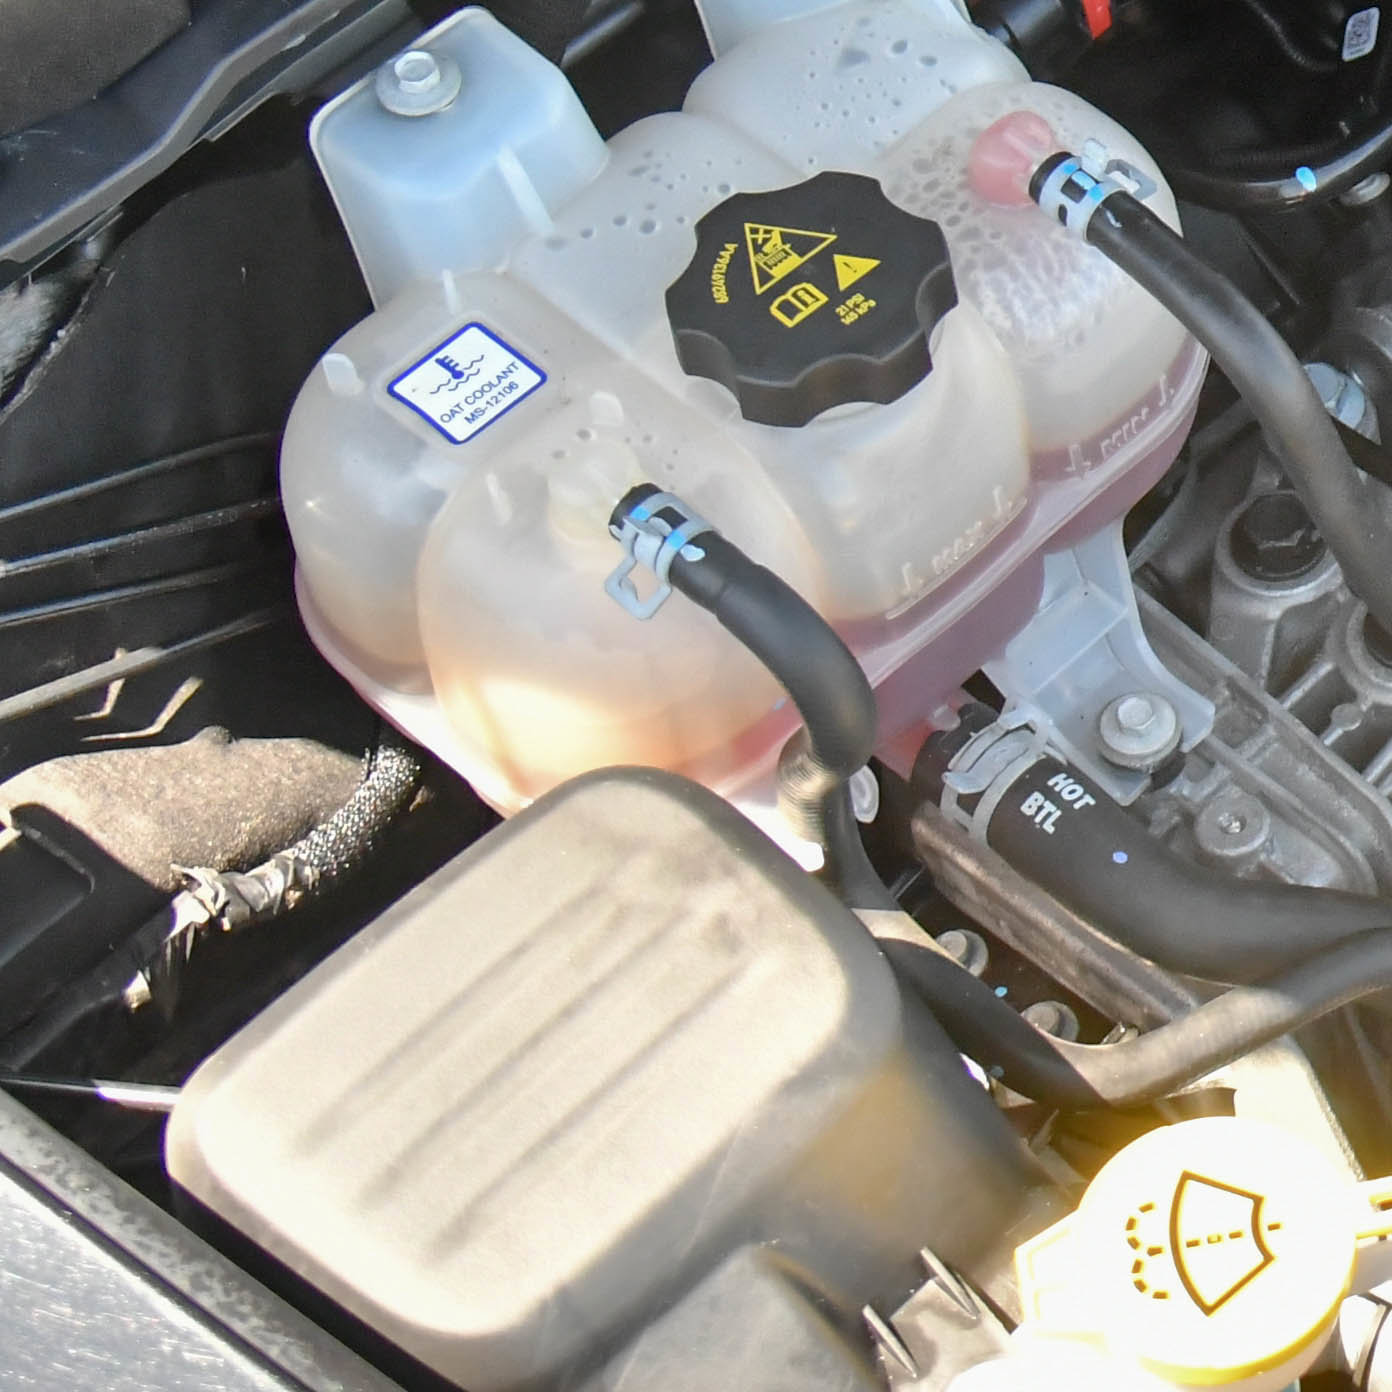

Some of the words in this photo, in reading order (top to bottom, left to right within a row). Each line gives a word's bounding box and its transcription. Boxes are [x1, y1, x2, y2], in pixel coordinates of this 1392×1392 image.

[846, 293, 867, 310] PSI
[440, 403, 465, 424] OAT
[464, 361, 520, 406] COOLANT
[463, 380, 519, 424] MS-12106
[1019, 791, 1063, 835] BTL
[1047, 773, 1097, 810] HOT
